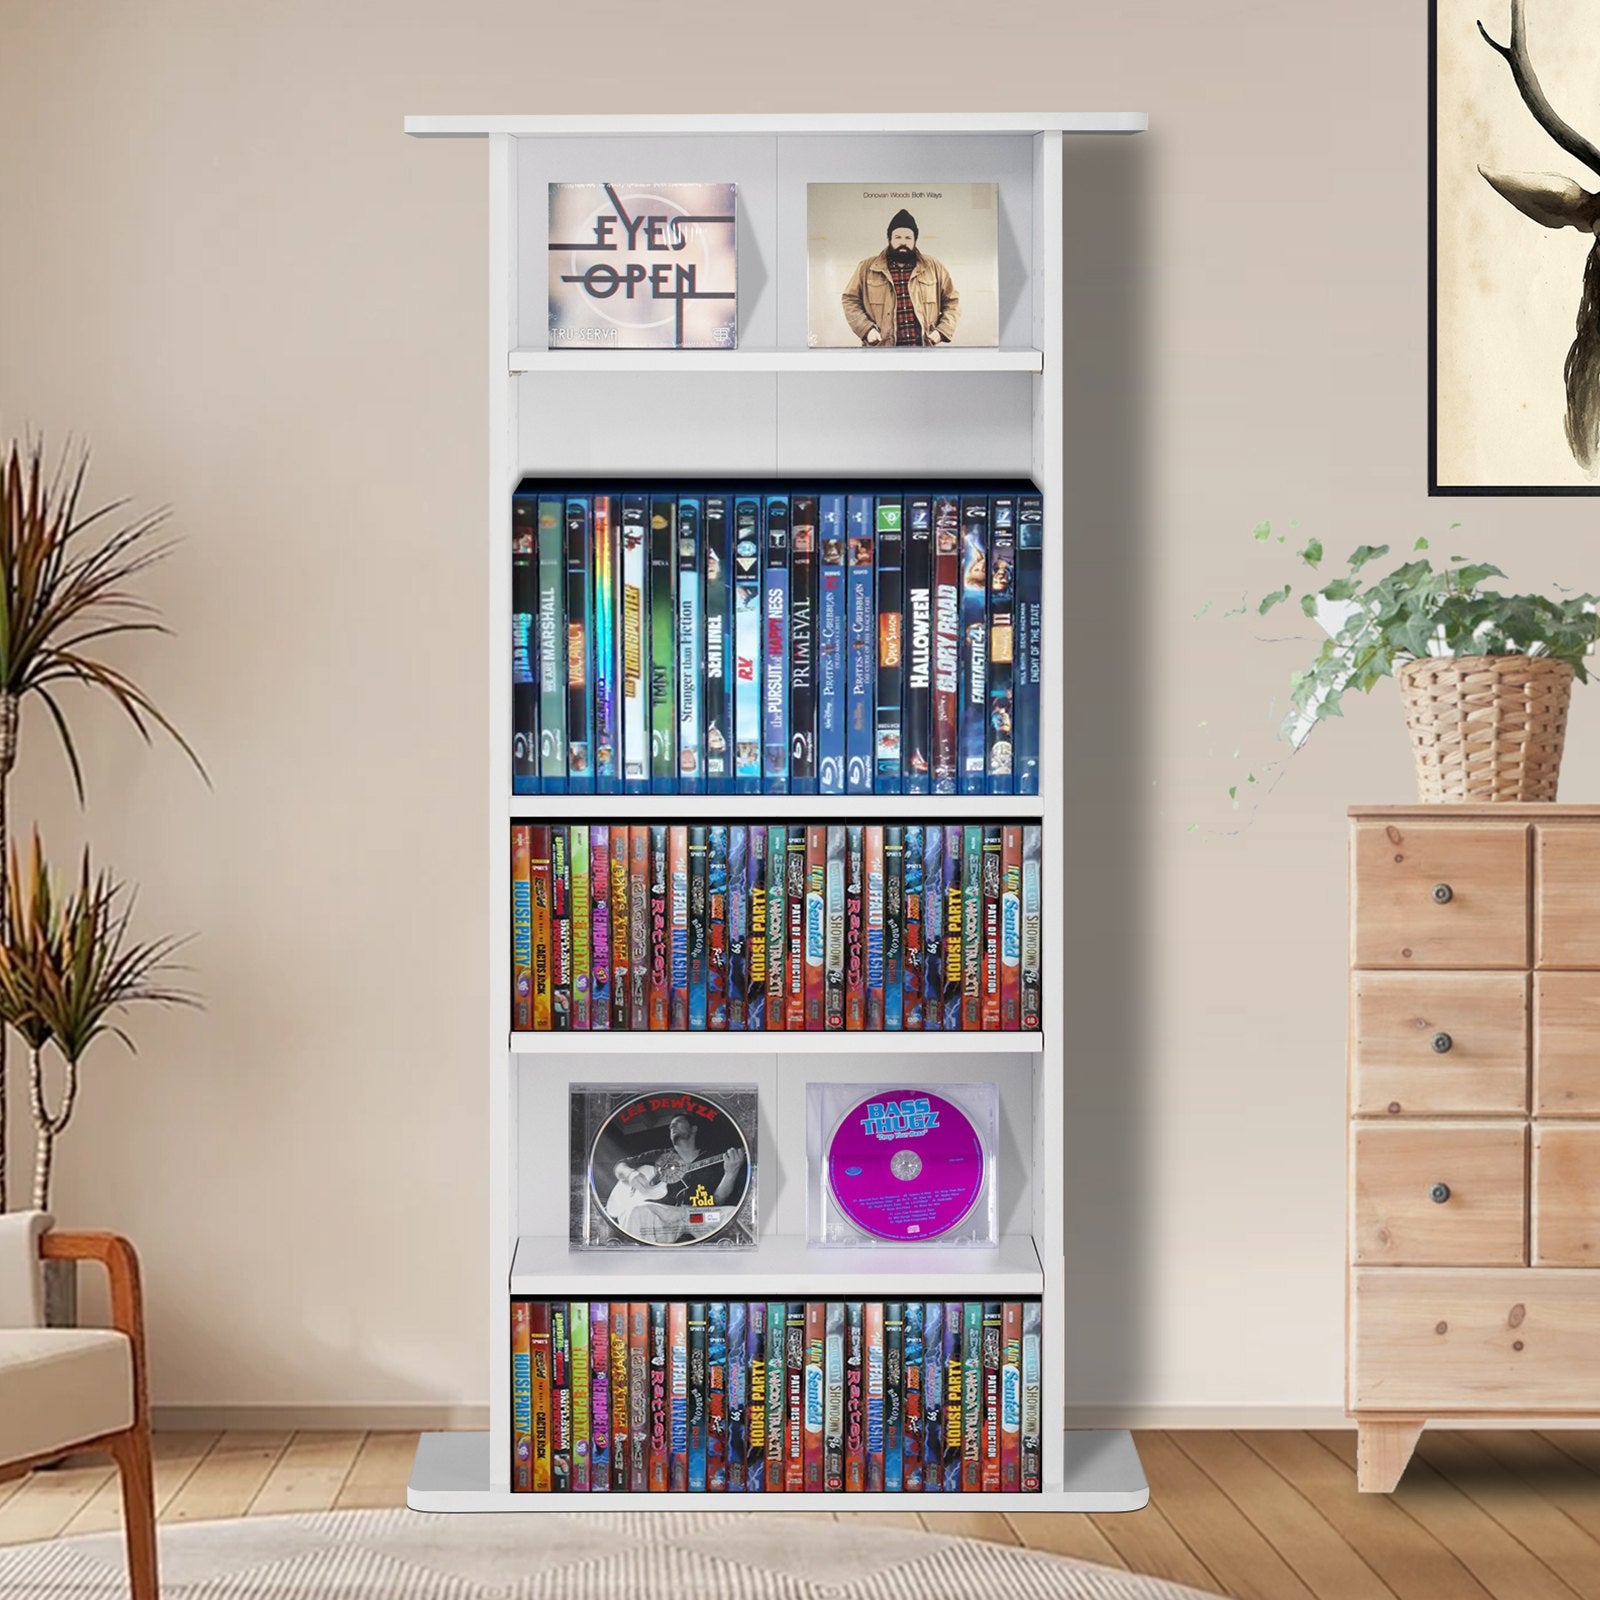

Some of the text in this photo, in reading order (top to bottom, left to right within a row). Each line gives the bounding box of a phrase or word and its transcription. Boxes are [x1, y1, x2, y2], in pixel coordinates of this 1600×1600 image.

[863, 191, 942, 200] Donovan Woods Both Ways
[593, 215, 686, 251] EYES
[583, 264, 697, 299] OPEN
[540, 587, 555, 660] MARSHALL
[624, 584, 641, 680] TRANSPORTER
[768, 588, 783, 655] HAPPYNESS
[883, 612, 899, 640] SEASON
[937, 584, 956, 634] ROAD
[569, 622, 584, 686] VACANCY
[680, 600, 696, 723] Stranger than Fiction
[707, 614, 722, 678] SENTINEL
[793, 597, 810, 687] PRIMEVAL
[852, 583, 864, 694] PIRATES CARIBBEAN
[911, 588, 929, 688] HALLOWEEN
[937, 634, 957, 693] GLORY
[1029, 602, 1040, 683] ENEMY OF THE STATE
[653, 662, 667, 707] TMNT
[768, 664, 783, 712] PURSUIT
[823, 659, 835, 696] PIRATES
[972, 642, 984, 704] FANTASTIC
[770, 711, 783, 728] the
[593, 845, 608, 901] NOVEMBER
[831, 891, 842, 911] CITY
[1027, 891, 1038, 911] CITY
[514, 881, 531, 967] HOUSE PARTY
[573, 877, 588, 972] HOUSE PARTY
[593, 909, 609, 966] REMEMBER
[672, 872, 687, 989] BUFFALO INVASION
[751, 887, 766, 982] HOUSE PARTY
[792, 904, 801, 925] PATH
[792, 926, 801, 936] OF
[808, 898, 824, 958] Seinfeld
[831, 915, 843, 967] SHOWDOWN
[868, 872, 883, 989] BUFFALO INVASION
[947, 887, 962, 982] HOUSE PARTY
[988, 904, 997, 925] PATH
[988, 926, 997, 936] OF
[1004, 898, 1020, 958] Seinfeld
[1027, 915, 1039, 967] SHOWDOWN
[536, 944, 546, 995] CACTUS JACK
[792, 938, 801, 993] DESTRUCTION
[988, 938, 997, 993] DESTRUCTION
[619, 1094, 718, 1125] LEE DEWYZE
[860, 1111, 940, 1136] THUGZ
[867, 1098, 931, 1119] BASS
[689, 1194, 715, 1207] Told
[593, 1321, 608, 1372] NOVEMBER
[831, 1363, 842, 1381] CITY
[1027, 1363, 1038, 1381] CITY
[514, 1354, 531, 1433] HOUSE PARTY
[573, 1350, 588, 1438] HOUSE PARTY
[593, 1380, 609, 1432] REMEMBER
[672, 1345, 687, 1453] BUFFALO INVASION
[751, 1359, 766, 1447] HOUSE PARTY
[792, 1375, 801, 1457] PATH OF DESTRUCTION
[808, 1369, 824, 1425] Seinfeld
[831, 1385, 843, 1433] SHOWDOWN
[868, 1345, 883, 1453] BUFFALO INVASION
[947, 1359, 962, 1447] HOUSE PARTY
[988, 1375, 997, 1457] PATH OF DESTRUCTION
[1004, 1369, 1020, 1425] Seinfeld
[1027, 1385, 1039, 1433] SHOWDOWN
[536, 1412, 546, 1459] CACTUS JACK
